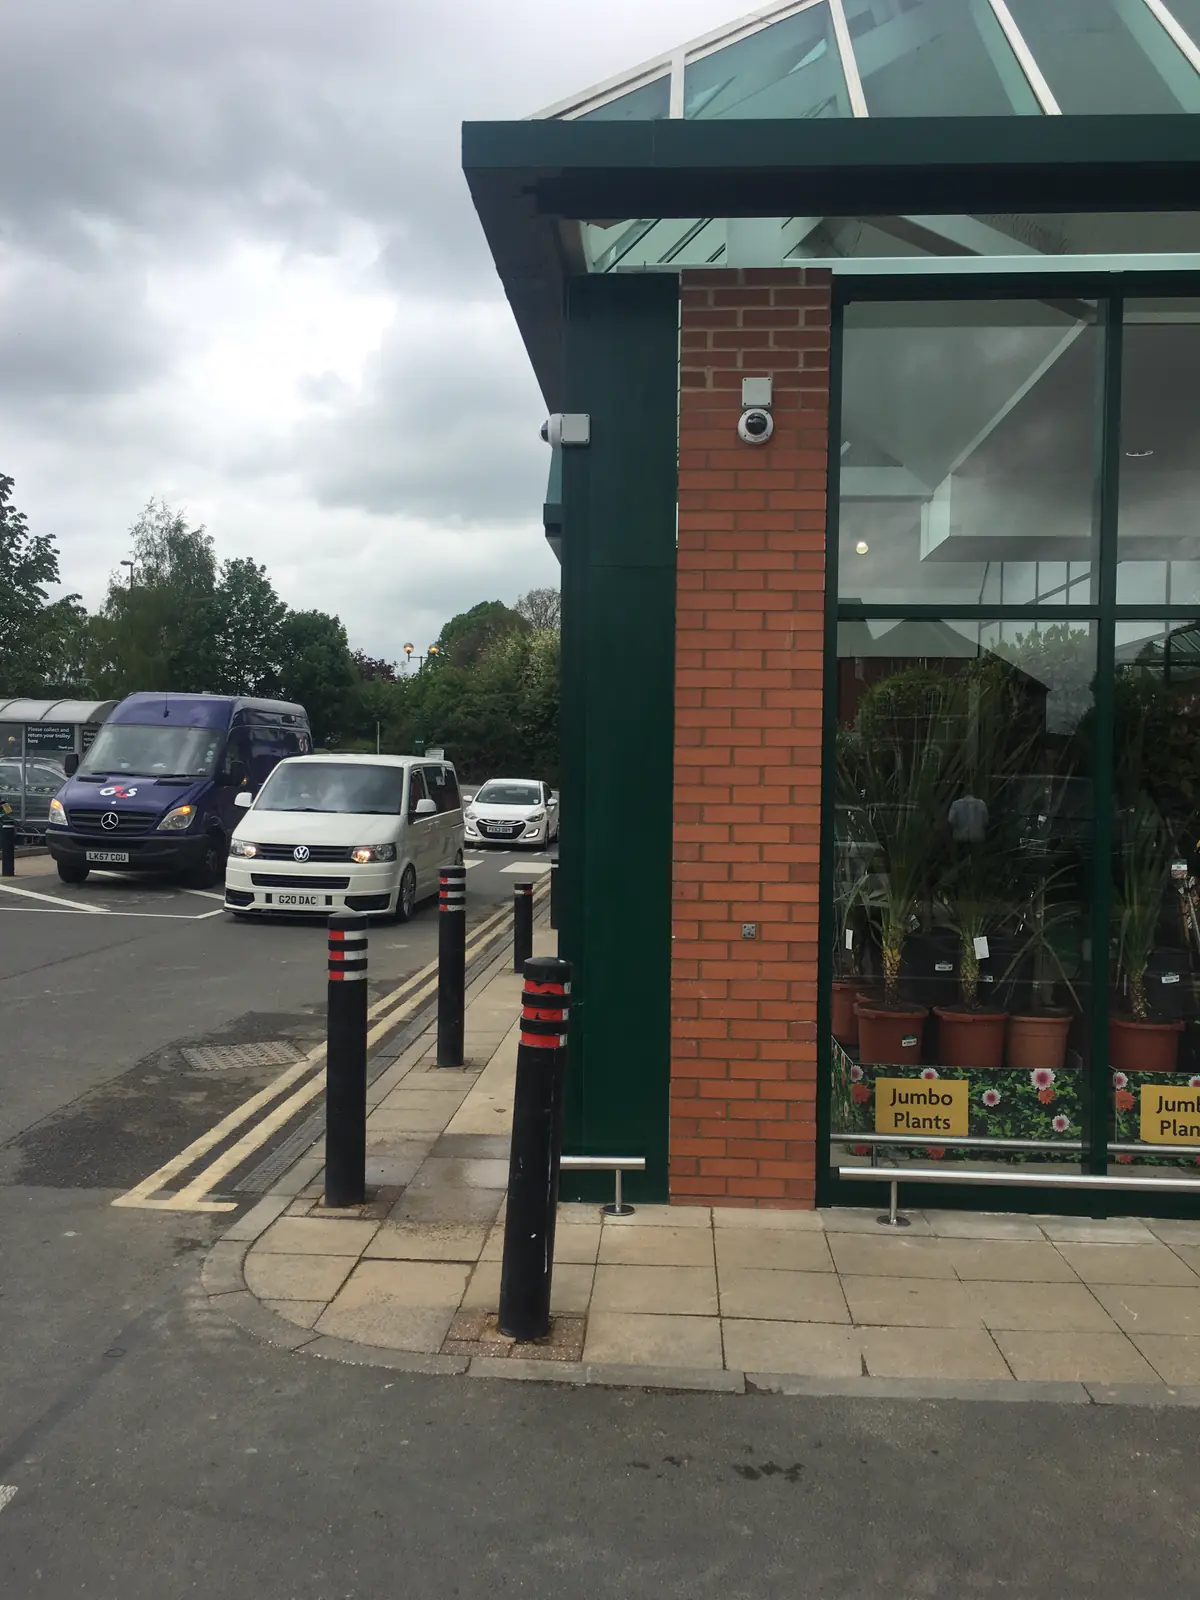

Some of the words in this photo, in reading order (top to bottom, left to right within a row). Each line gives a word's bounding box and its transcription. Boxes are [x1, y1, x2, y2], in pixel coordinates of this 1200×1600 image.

[100, 786, 138, 799] G4S
[88, 852, 109, 860] LK57
[278, 895, 297, 904] G20
[298, 895, 317, 905] DAC
[889, 1087, 953, 1107] Jumbo
[893, 1111, 951, 1130] Plants
